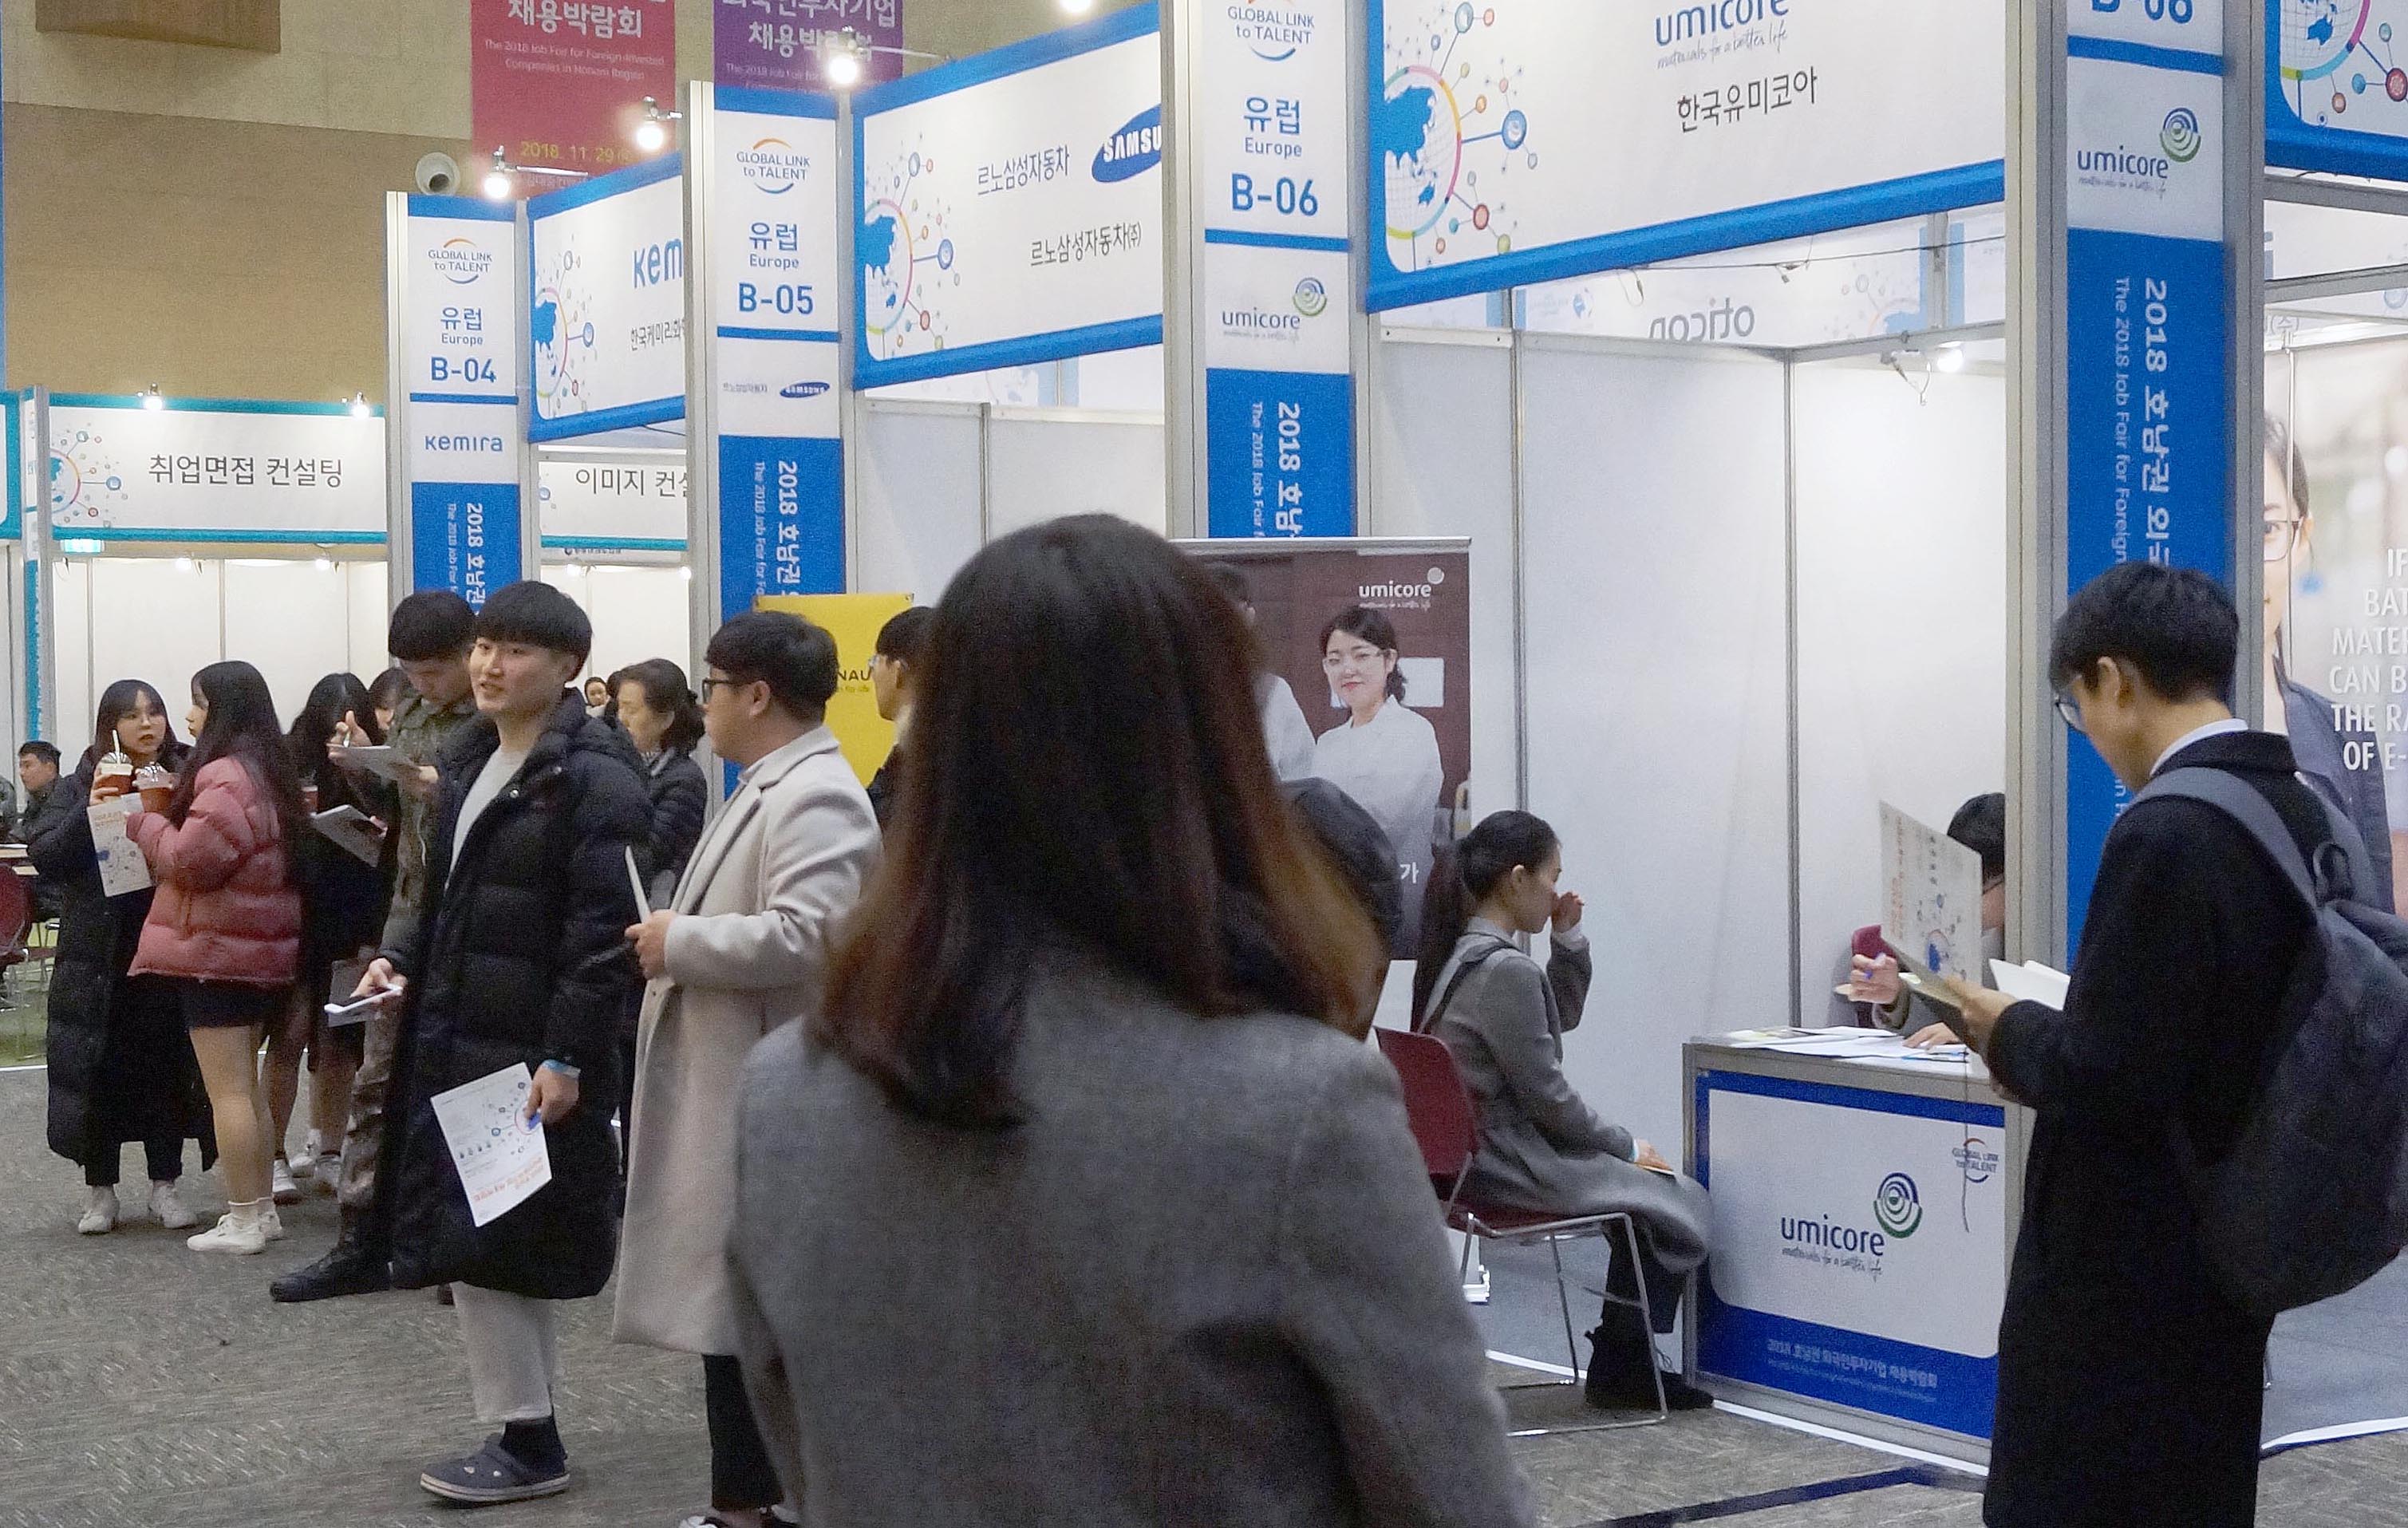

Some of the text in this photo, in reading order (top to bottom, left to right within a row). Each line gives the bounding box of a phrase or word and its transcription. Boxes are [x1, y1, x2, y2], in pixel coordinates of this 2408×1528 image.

[507, 0, 643, 38] 채용박람회
[1227, 6, 1315, 29] GLOBAL LINK
[1237, 26, 1312, 45] to TALENT
[1677, 65, 1818, 133] 한국유미코아
[1244, 97, 1301, 136] 유럽
[1103, 124, 1162, 163] SAMSU
[1245, 137, 1303, 160] Europe
[736, 151, 811, 168] GLOBAL LINK
[743, 166, 808, 181] to TALENT
[977, 144, 1070, 195] 르노삼성자동차
[2077, 145, 2169, 179] umicore
[1231, 172, 1319, 217] B-06
[749, 222, 798, 251] 유럽
[428, 249, 493, 263] GLOBAL LINK
[434, 260, 491, 273] to TALENT
[634, 239, 684, 289] kem
[750, 253, 799, 270] Europe
[738, 282, 814, 314] B-05
[440, 307, 483, 331] 유럽
[1222, 307, 1301, 330] umicore
[2145, 276, 2168, 373] 2018
[441, 333, 484, 348] Europe
[431, 357, 497, 383] B-04
[1252, 401, 1263, 428] The
[2111, 277, 2131, 564] The 2018 Job Fair for Foreign
[424, 435, 503, 452] kemira
[1278, 401, 1301, 472] 2018
[2142, 385, 2169, 492] 호남권
[148, 453, 343, 488] 취업면접 컨설팅
[575, 468, 644, 496] 이미지
[778, 460, 798, 515] 2018
[467, 503, 484, 547] 2018
[776, 521, 801, 585] 호남권
[1358, 580, 1432, 598] umicore
[2330, 664, 2381, 694] CAN
[2330, 702, 2375, 732] THE
[2343, 740, 2375, 771] OF
[1781, 1213, 1885, 1257] umicore
